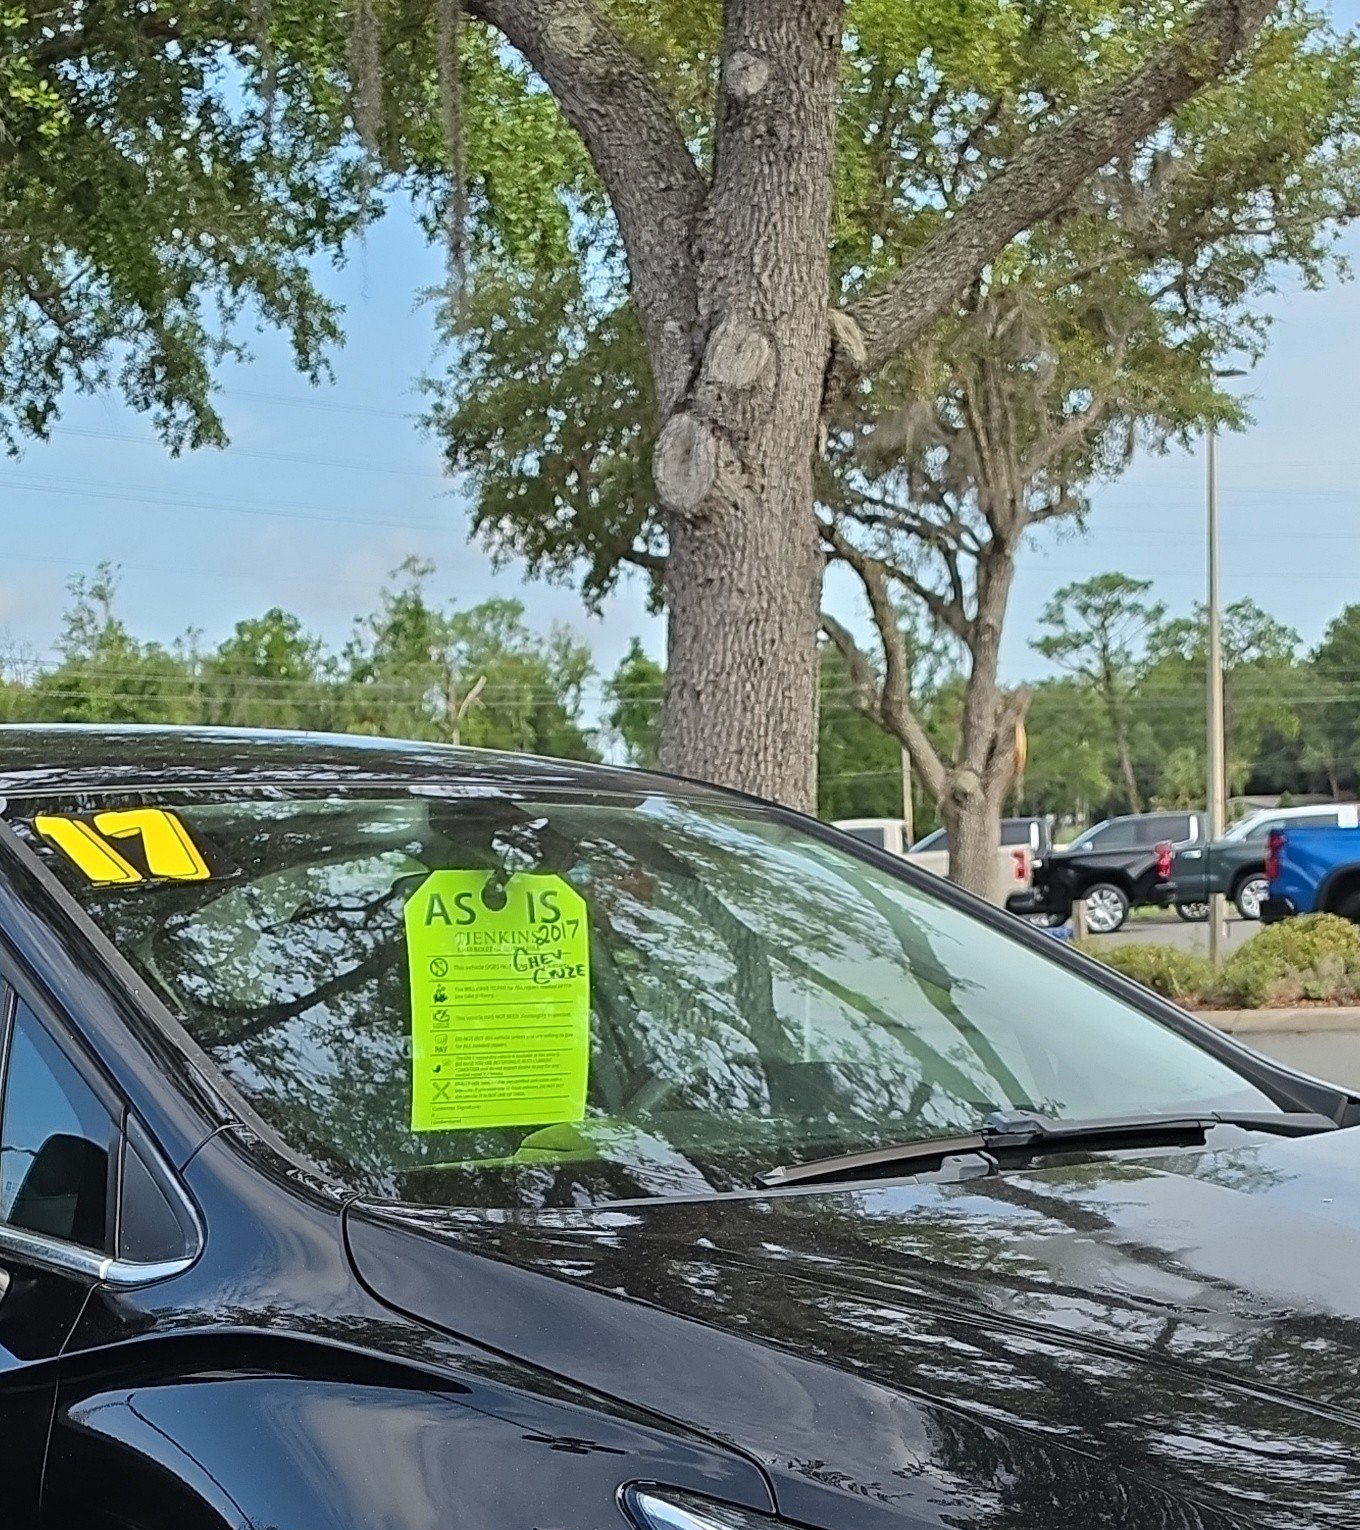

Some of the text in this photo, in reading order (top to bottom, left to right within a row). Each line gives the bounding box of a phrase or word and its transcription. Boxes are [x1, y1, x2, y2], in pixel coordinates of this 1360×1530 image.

[34, 808, 211, 888] 17
[424, 890, 561, 926] AS IS
[535, 918, 579, 946] 2017
[513, 947, 562, 973] CHEV
